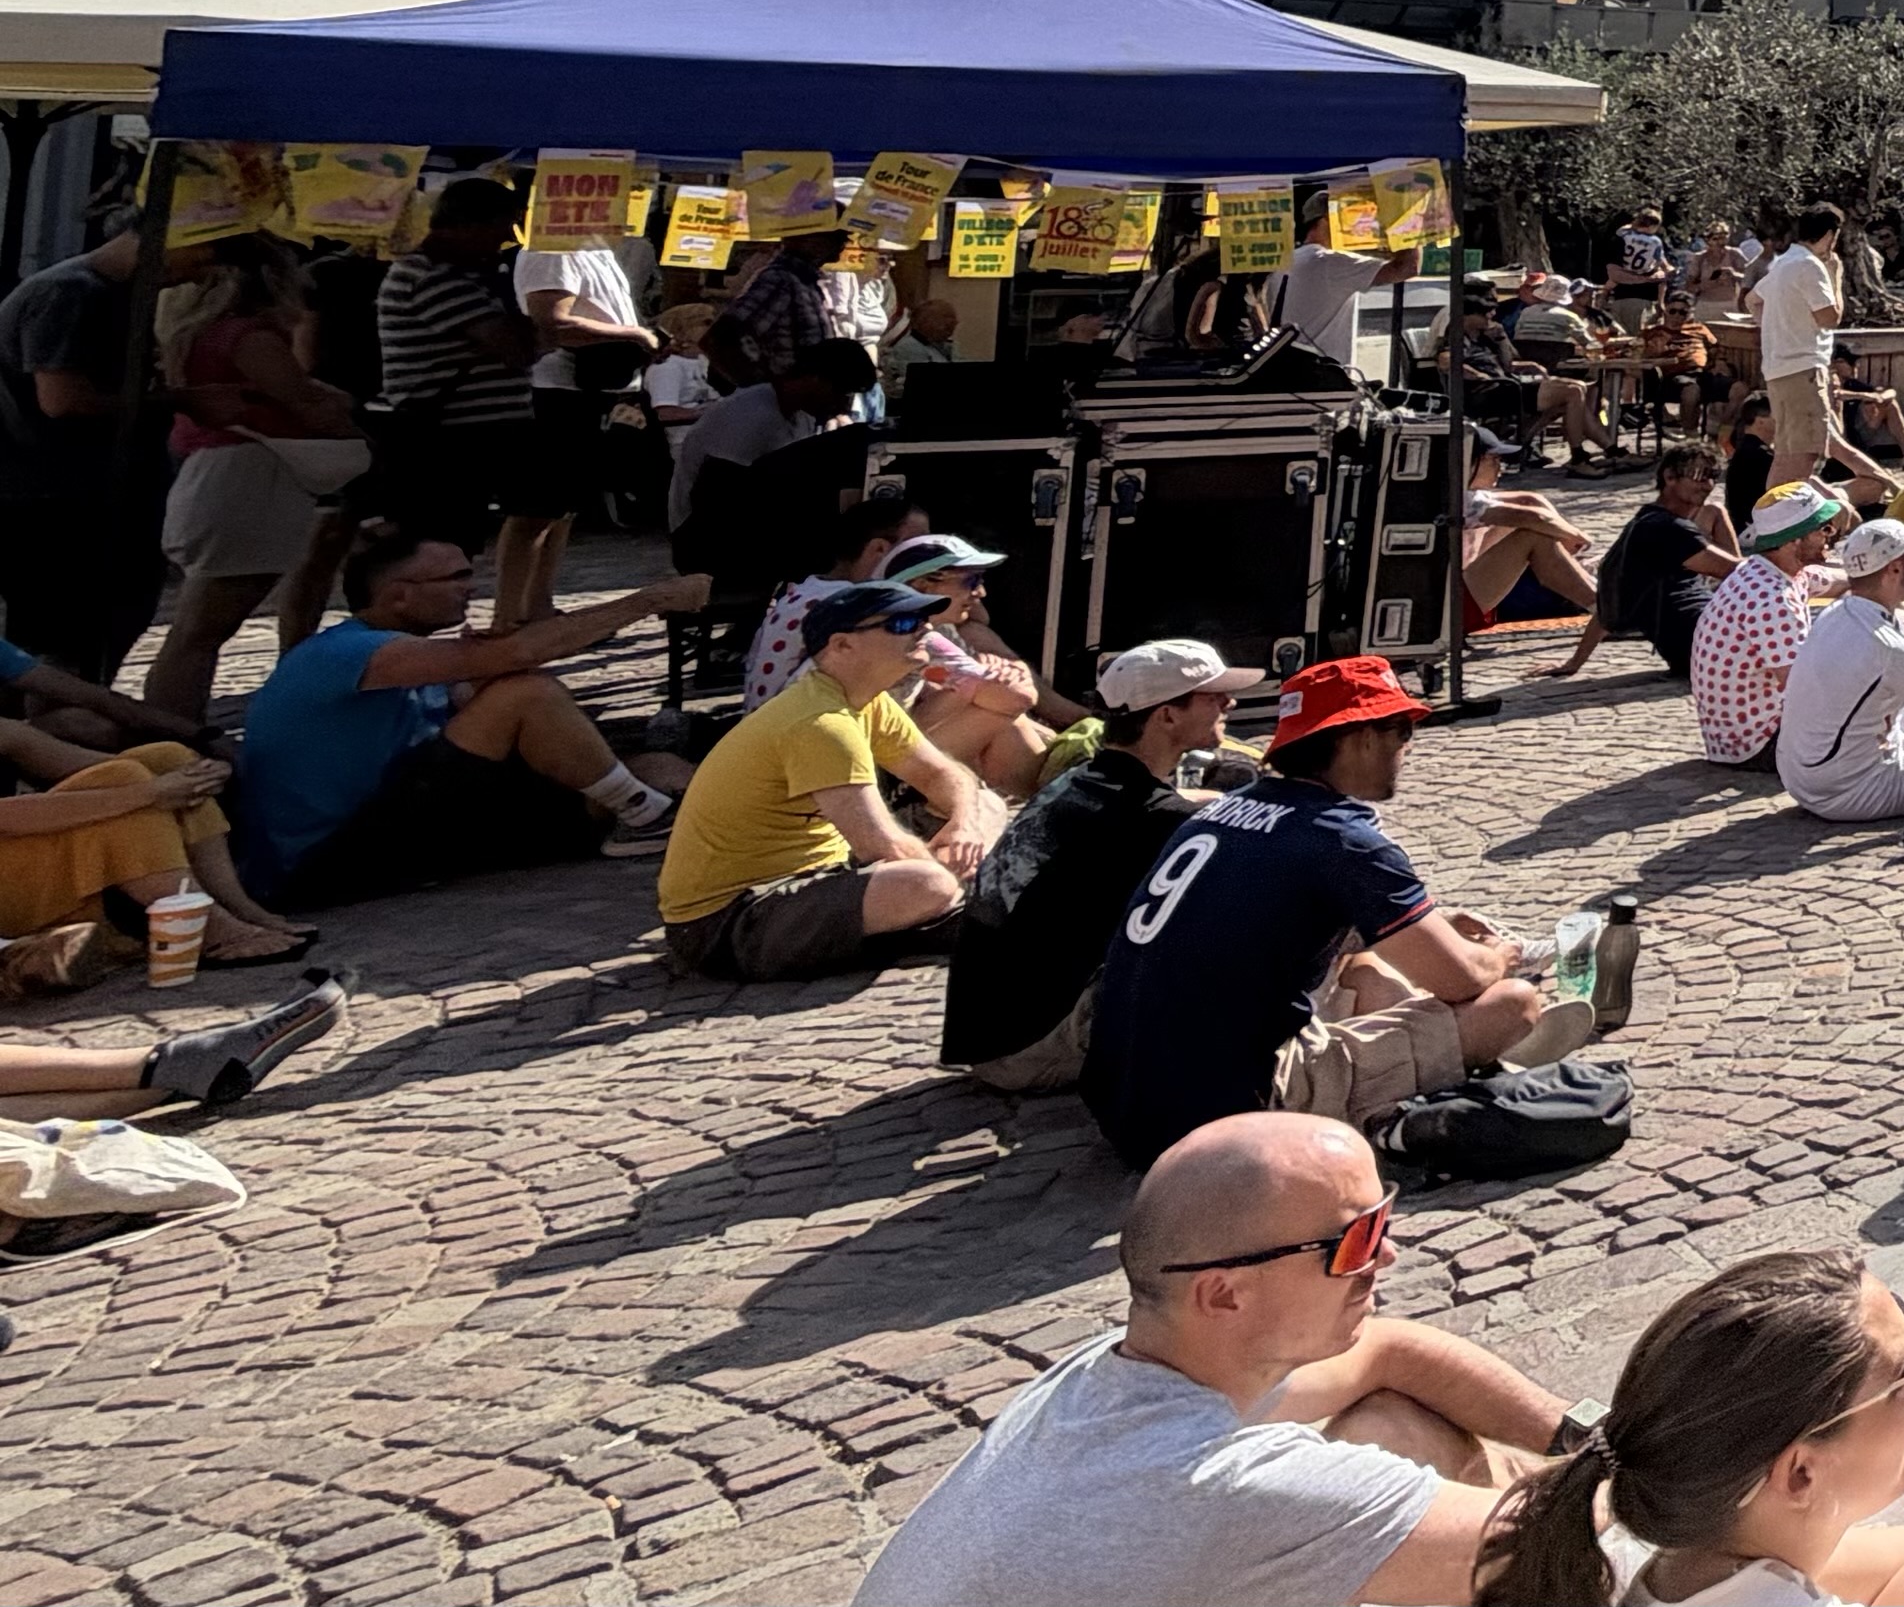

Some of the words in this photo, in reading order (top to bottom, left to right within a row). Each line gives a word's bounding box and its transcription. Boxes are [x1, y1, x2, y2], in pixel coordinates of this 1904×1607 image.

[900, 160, 934, 180] Tour
[546, 174, 620, 197] MON
[875, 169, 894, 182] de
[894, 173, 940, 197] France
[1038, 240, 1102, 259] juillet
[1126, 833, 1218, 945] 9
